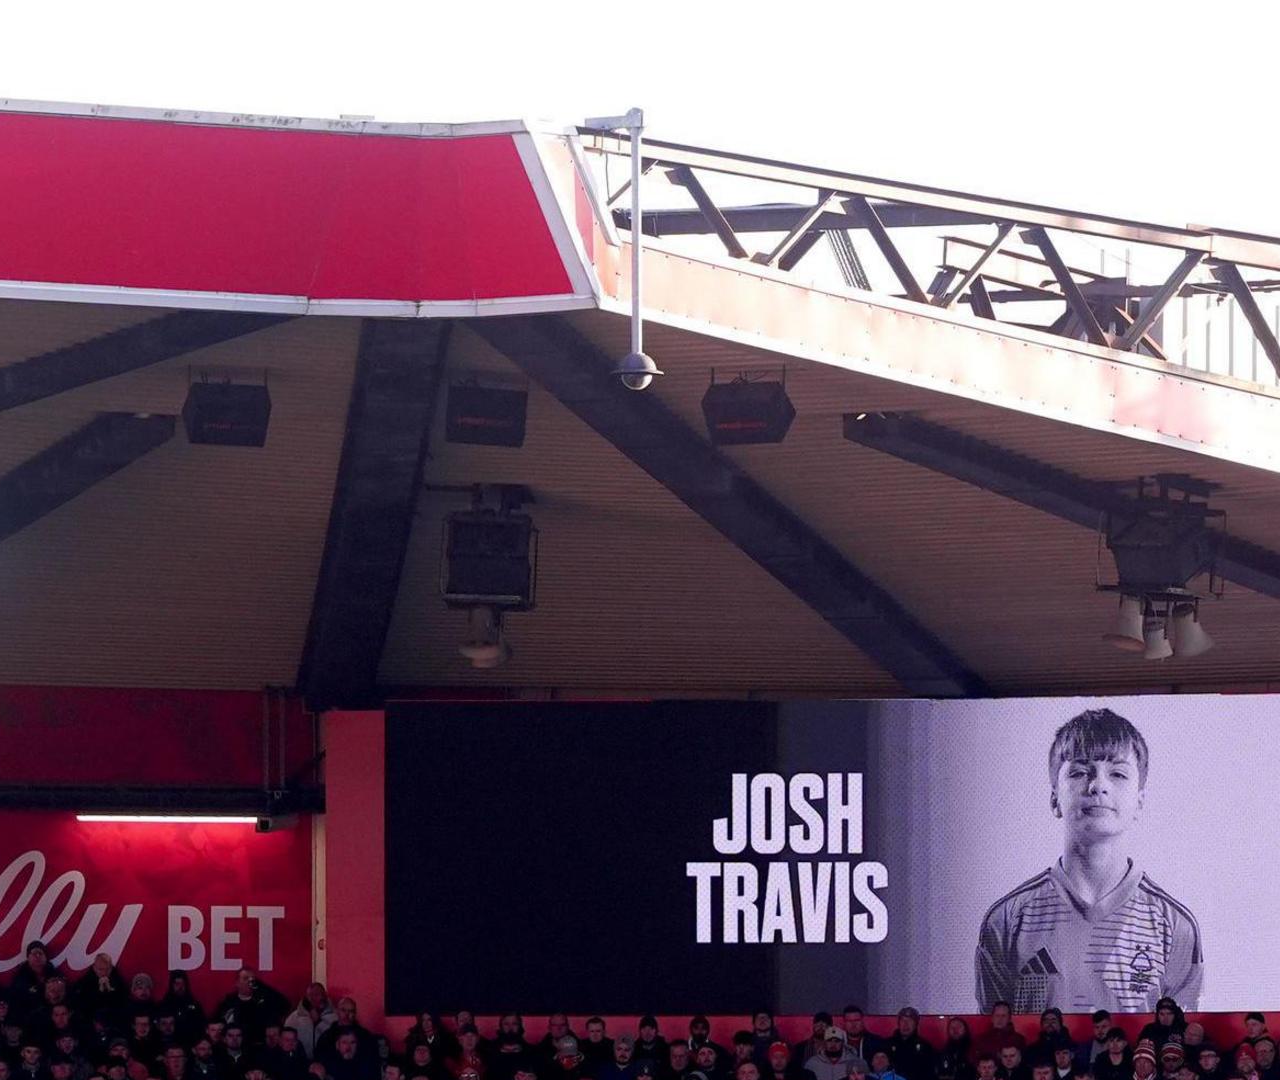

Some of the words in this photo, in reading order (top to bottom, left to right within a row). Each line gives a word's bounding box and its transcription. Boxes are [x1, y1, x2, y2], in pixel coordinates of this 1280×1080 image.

[713, 773, 863, 855] JOSH
[167, 905, 285, 971] BET
[686, 862, 889, 944] TRAVIS
